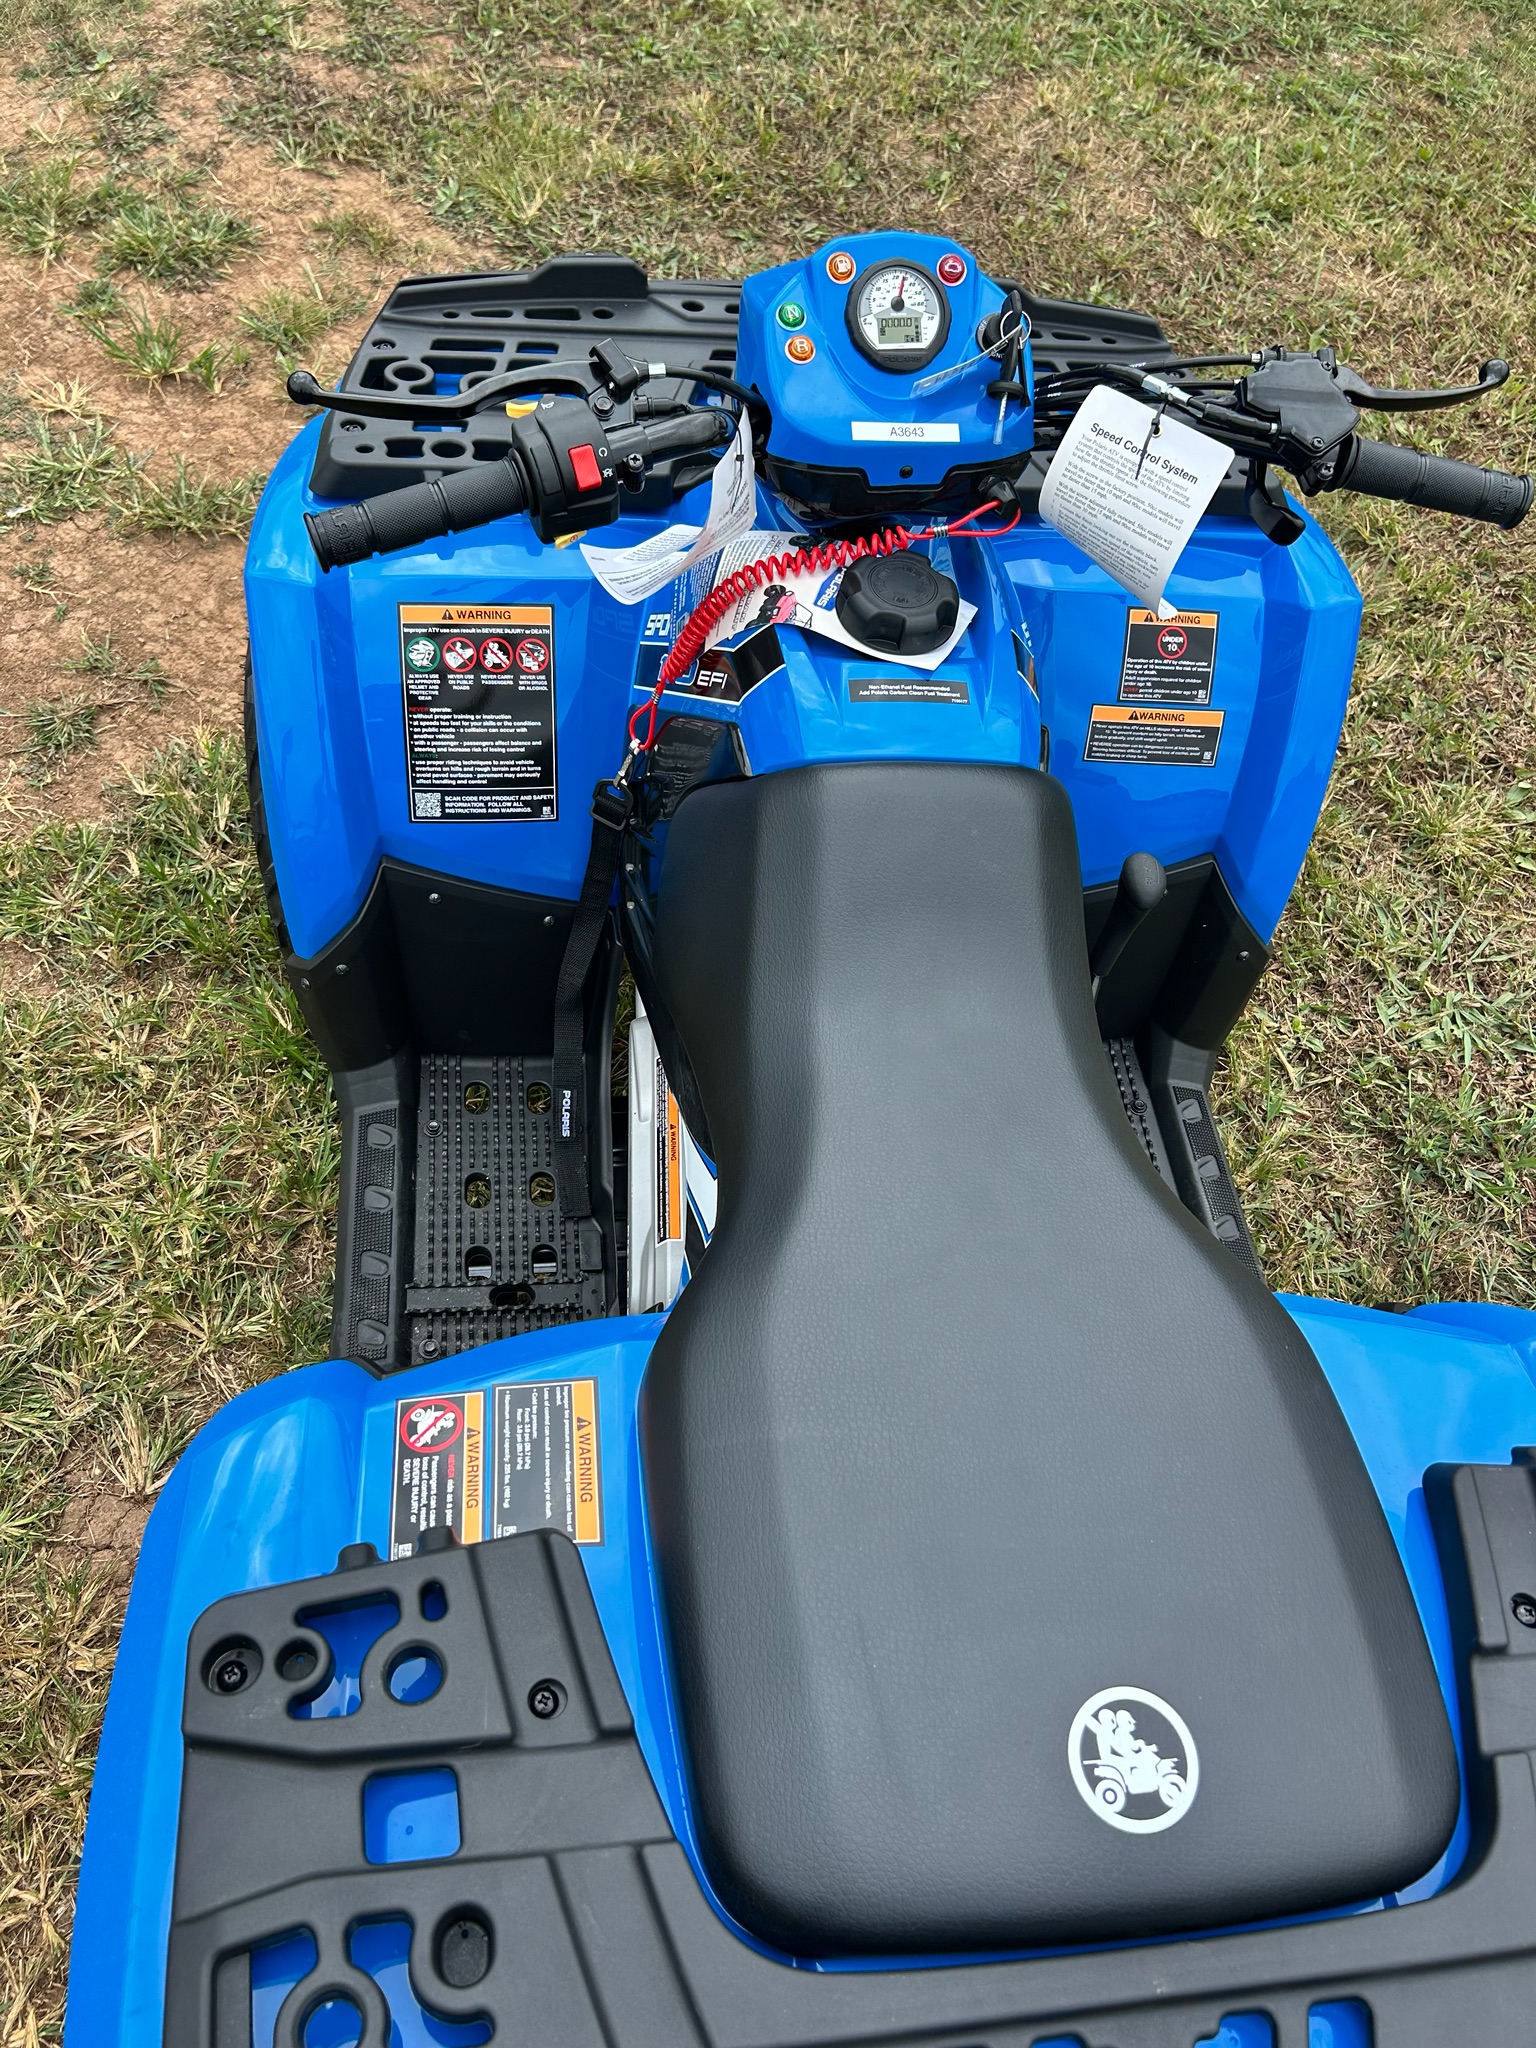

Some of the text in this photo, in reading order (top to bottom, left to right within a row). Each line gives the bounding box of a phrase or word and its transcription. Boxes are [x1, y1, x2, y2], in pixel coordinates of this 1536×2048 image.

[890, 427, 924, 437] A3643
[1090, 422, 1199, 485] Speed Conrol System
[456, 610, 511, 619] WARNING
[697, 670, 728, 689] EFI
[1138, 711, 1185, 721] WARNING
[562, 1090, 571, 1137] POLARIS
[466, 1441, 479, 1509] WARNING
[577, 1432, 593, 1502] WARNING
